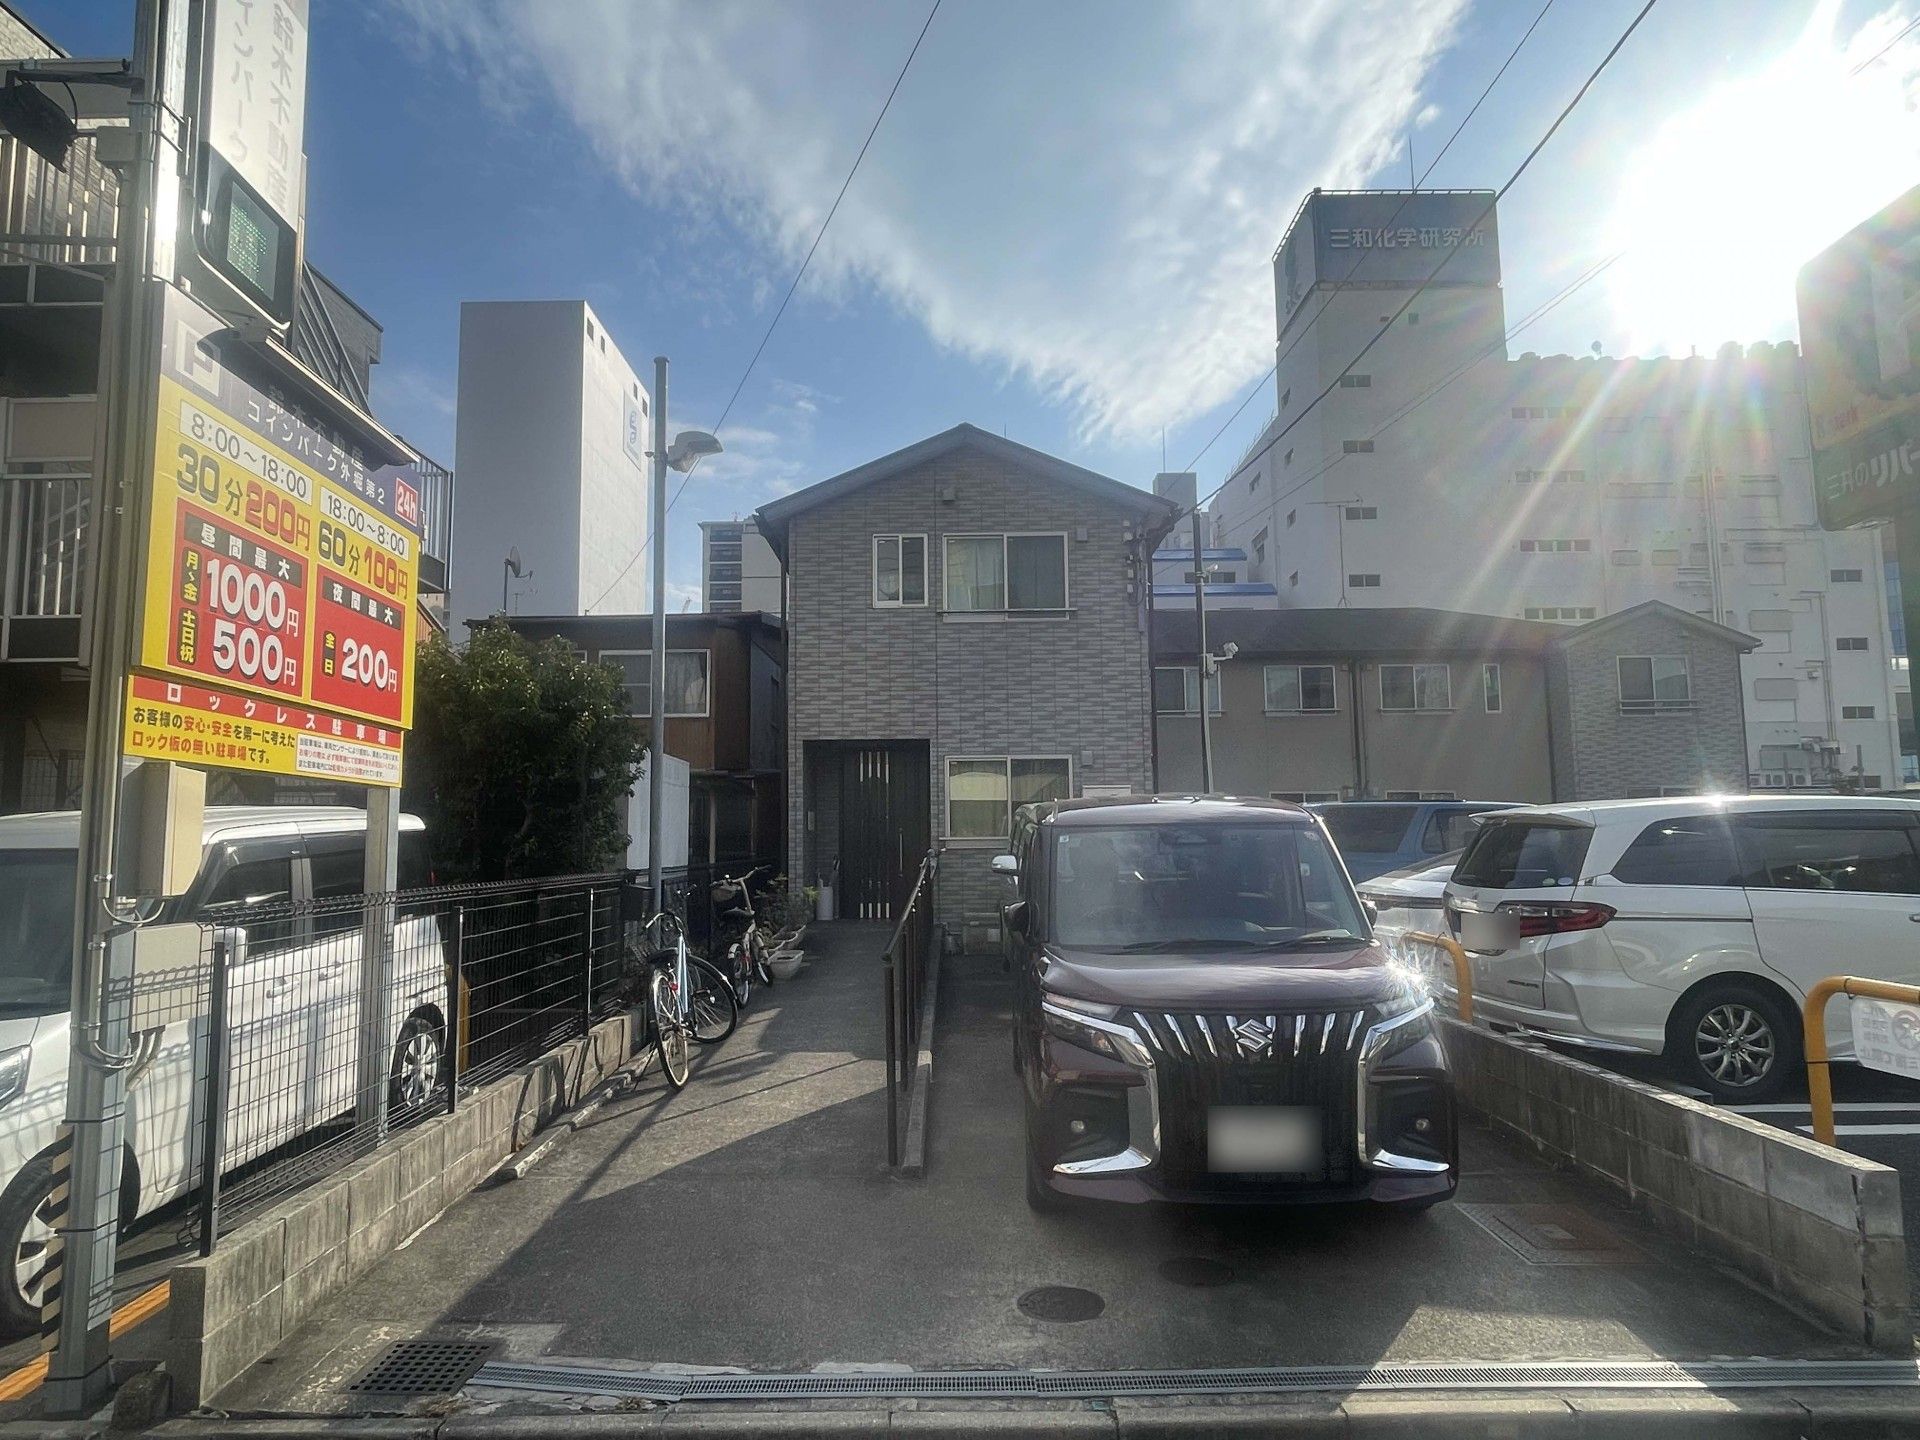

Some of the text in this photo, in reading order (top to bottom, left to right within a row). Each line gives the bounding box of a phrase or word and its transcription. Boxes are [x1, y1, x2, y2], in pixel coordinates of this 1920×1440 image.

[1331, 228, 1485, 248] 三和化学研究所
[397, 481, 417, 524] 24h
[202, 524, 290, 580] 昼間最大
[206, 559, 299, 637] 1000円
[333, 583, 393, 625] 夜間最大
[180, 610, 196, 664] 土日祝
[212, 618, 297, 687] 500円
[325, 632, 336, 673] 全日
[342, 638, 398, 693] 200円
[167, 682, 387, 744] ロックレス駐車場
[132, 731, 270, 764] ロック板の無い駐車場です。
